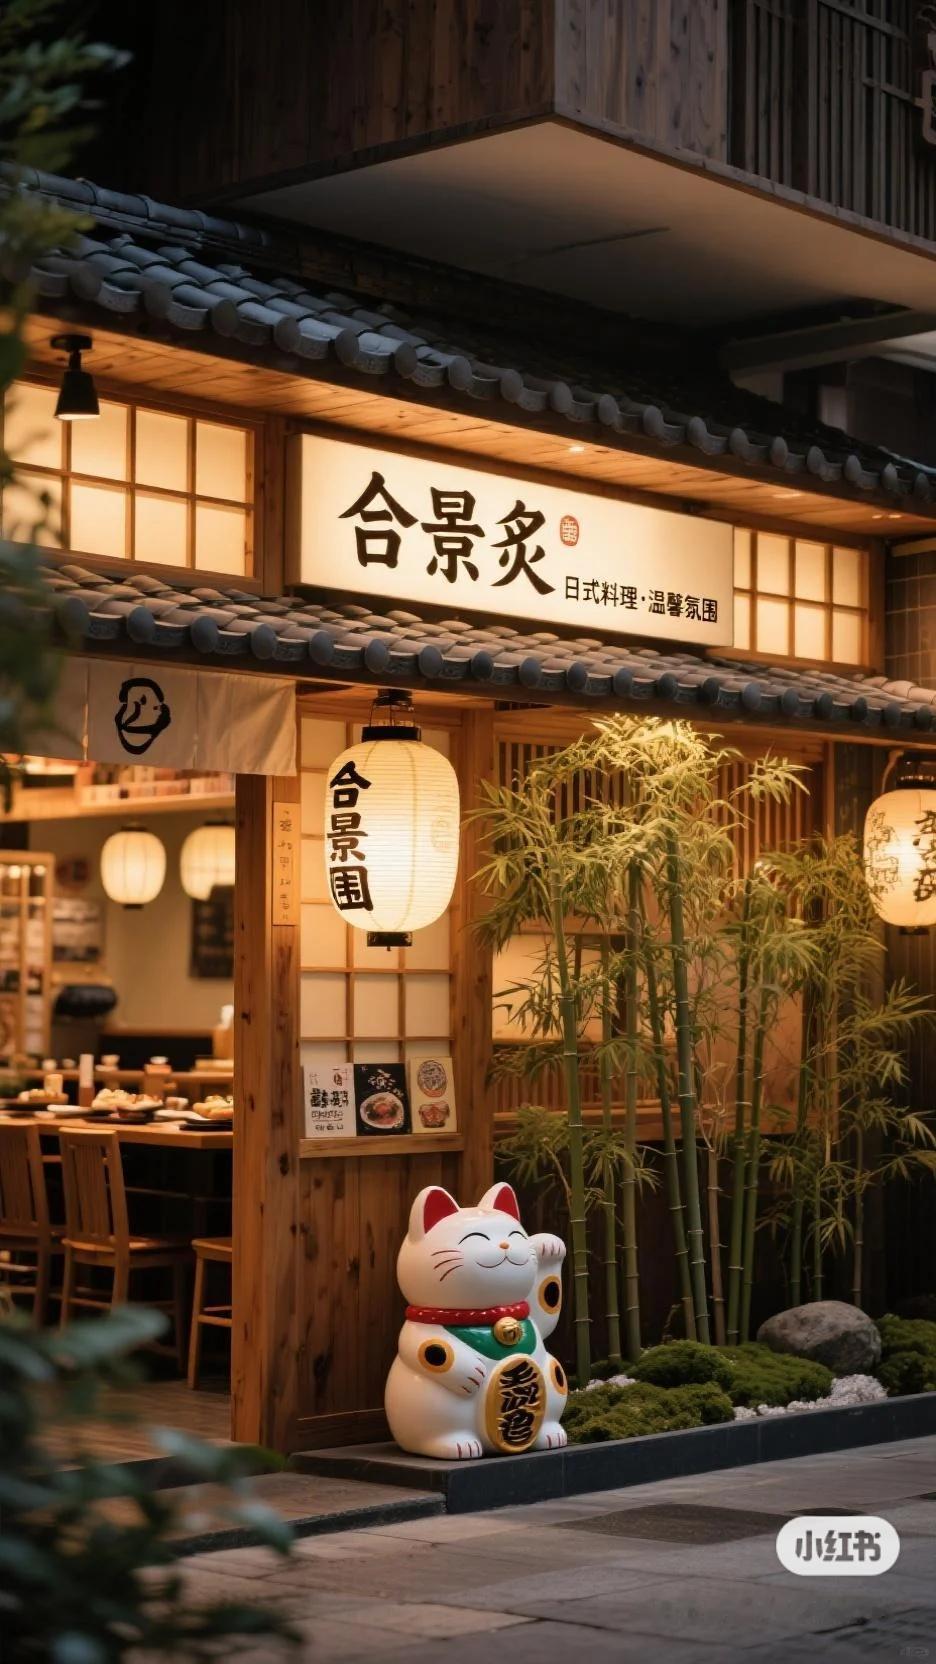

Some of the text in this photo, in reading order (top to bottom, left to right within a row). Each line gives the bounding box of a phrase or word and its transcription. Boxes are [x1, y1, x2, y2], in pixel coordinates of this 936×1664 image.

[338, 471, 556, 596] 合景炙
[565, 575, 718, 623] 日式料理·温馨氛围
[327, 760, 374, 912] 合景围
